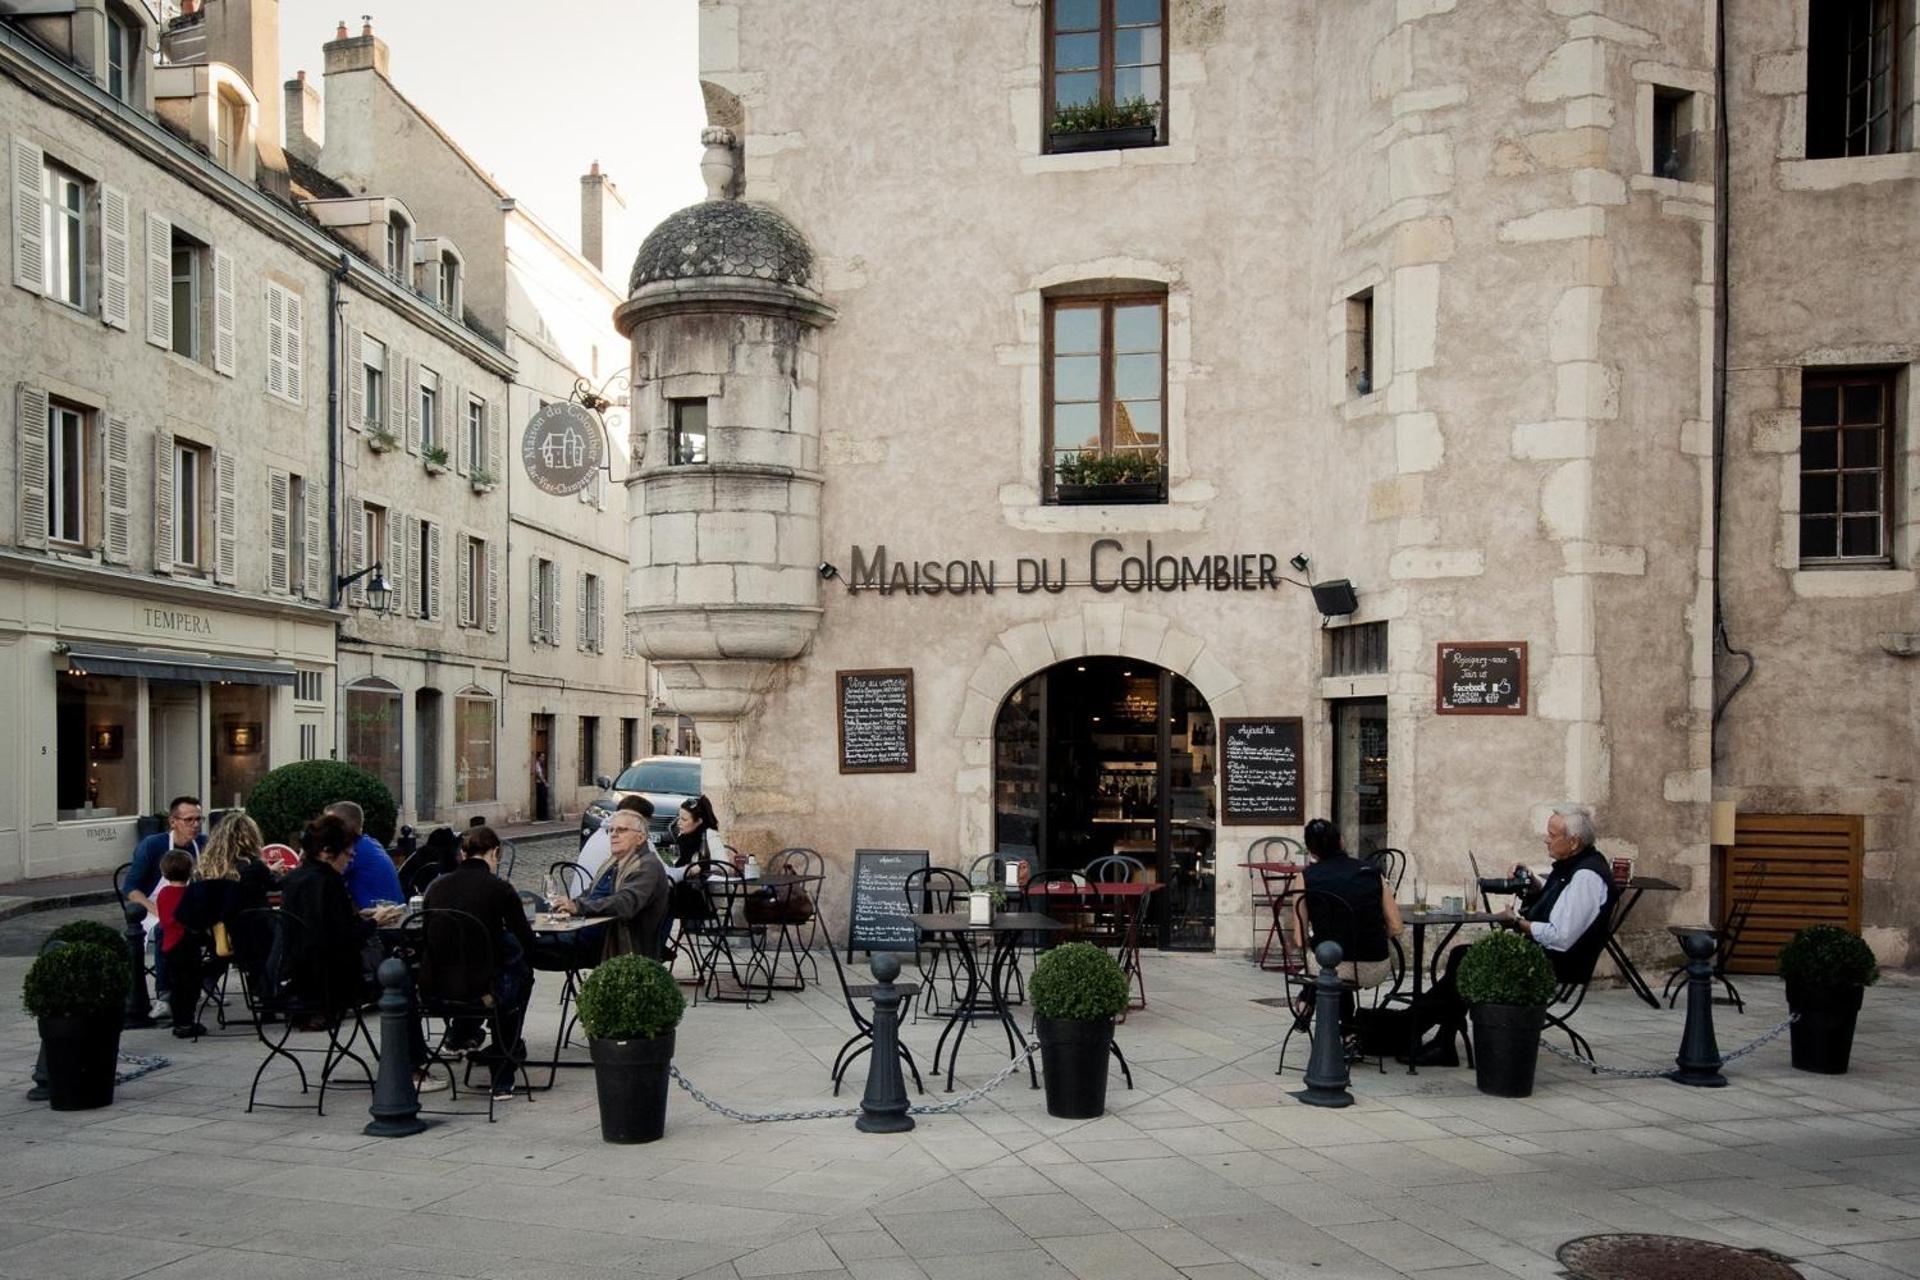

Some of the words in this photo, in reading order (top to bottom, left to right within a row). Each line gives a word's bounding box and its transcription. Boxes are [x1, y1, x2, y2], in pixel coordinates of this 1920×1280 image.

[523, 417, 547, 459] Maison
[567, 405, 602, 462] Colombier
[849, 545, 994, 595] MAISON
[1016, 557, 1067, 595] DU
[143, 608, 212, 634] TEMPERA
[1460, 668, 1477, 679] Join
[1350, 683, 1354, 695] 1
[1453, 682, 1487, 692] facebook
[41, 745, 47, 755] 5
